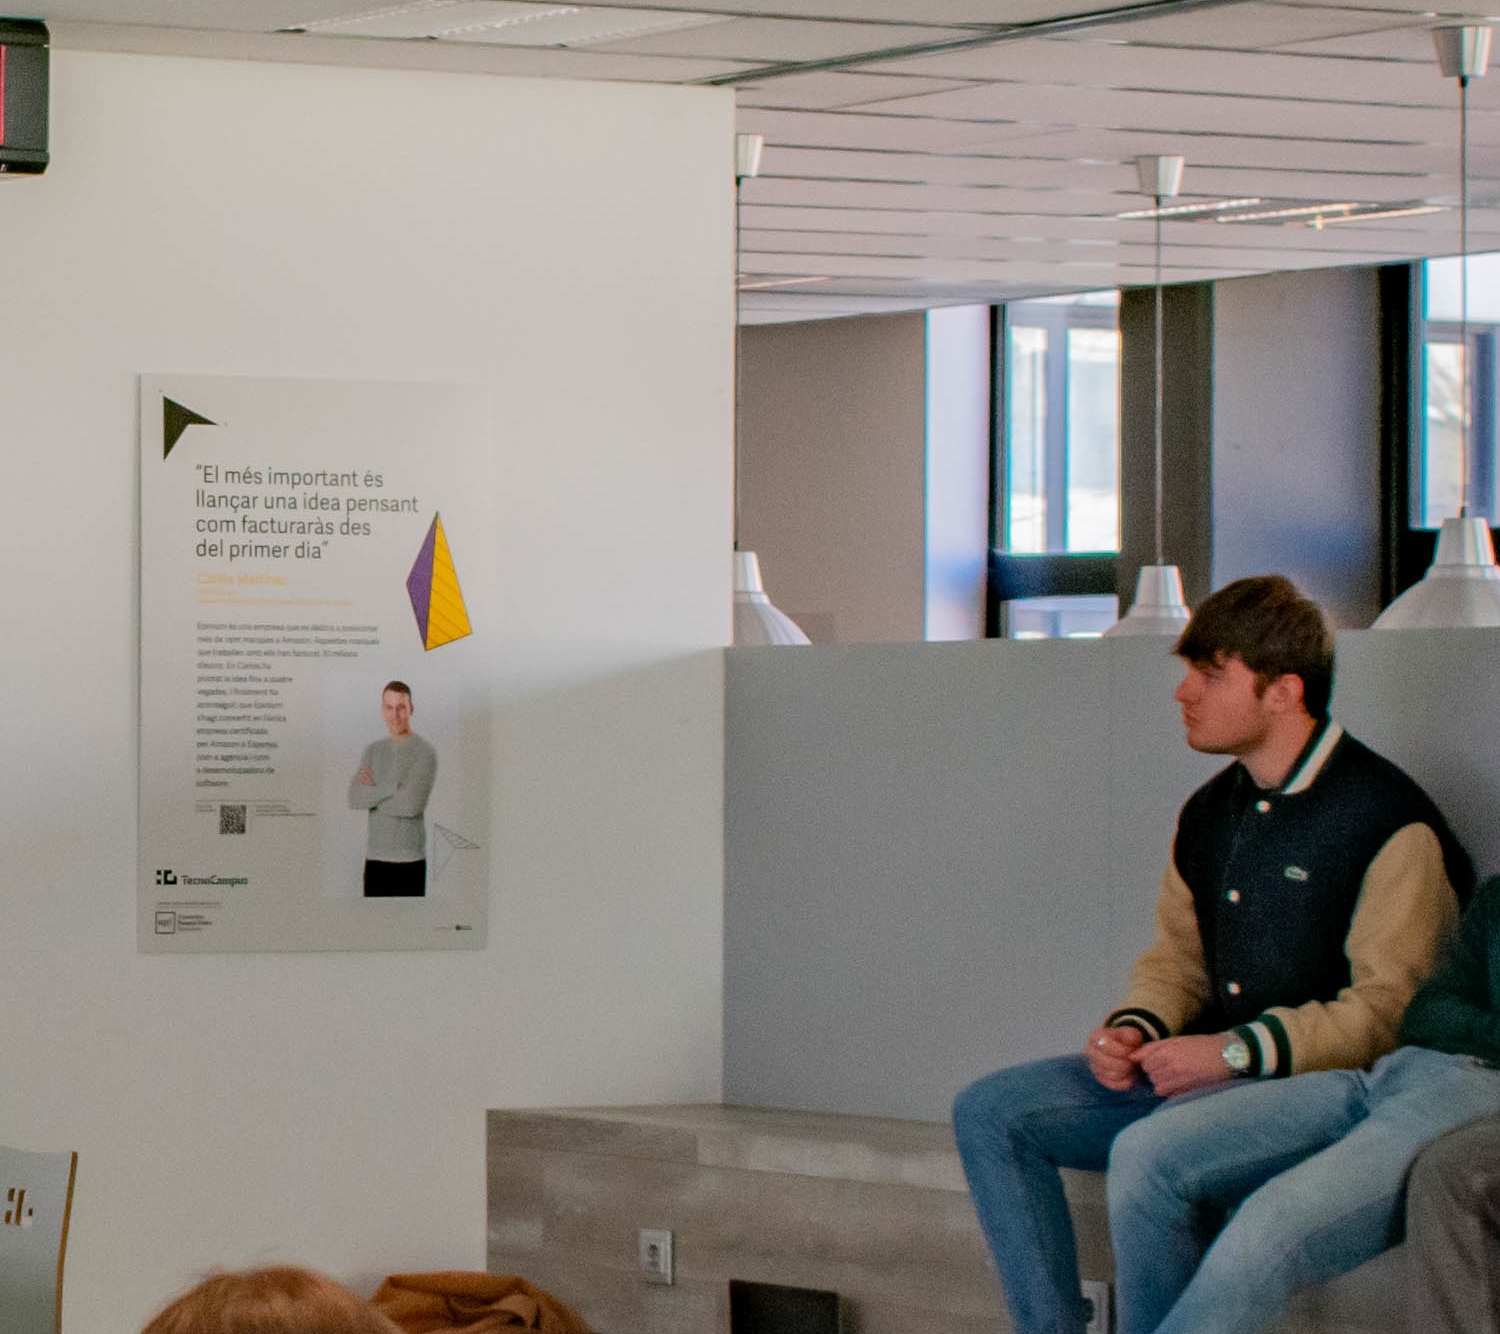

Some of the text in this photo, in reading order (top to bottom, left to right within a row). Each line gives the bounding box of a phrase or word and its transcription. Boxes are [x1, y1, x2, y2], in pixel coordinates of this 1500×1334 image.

[225, 465, 262, 485] més
[268, 467, 358, 489] important
[364, 470, 384, 488] és
[196, 489, 419, 517] llançar una idea pensant
[196, 515, 371, 536] com facturaràs des
[196, 539, 223, 557] del
[229, 540, 289, 562] primer
